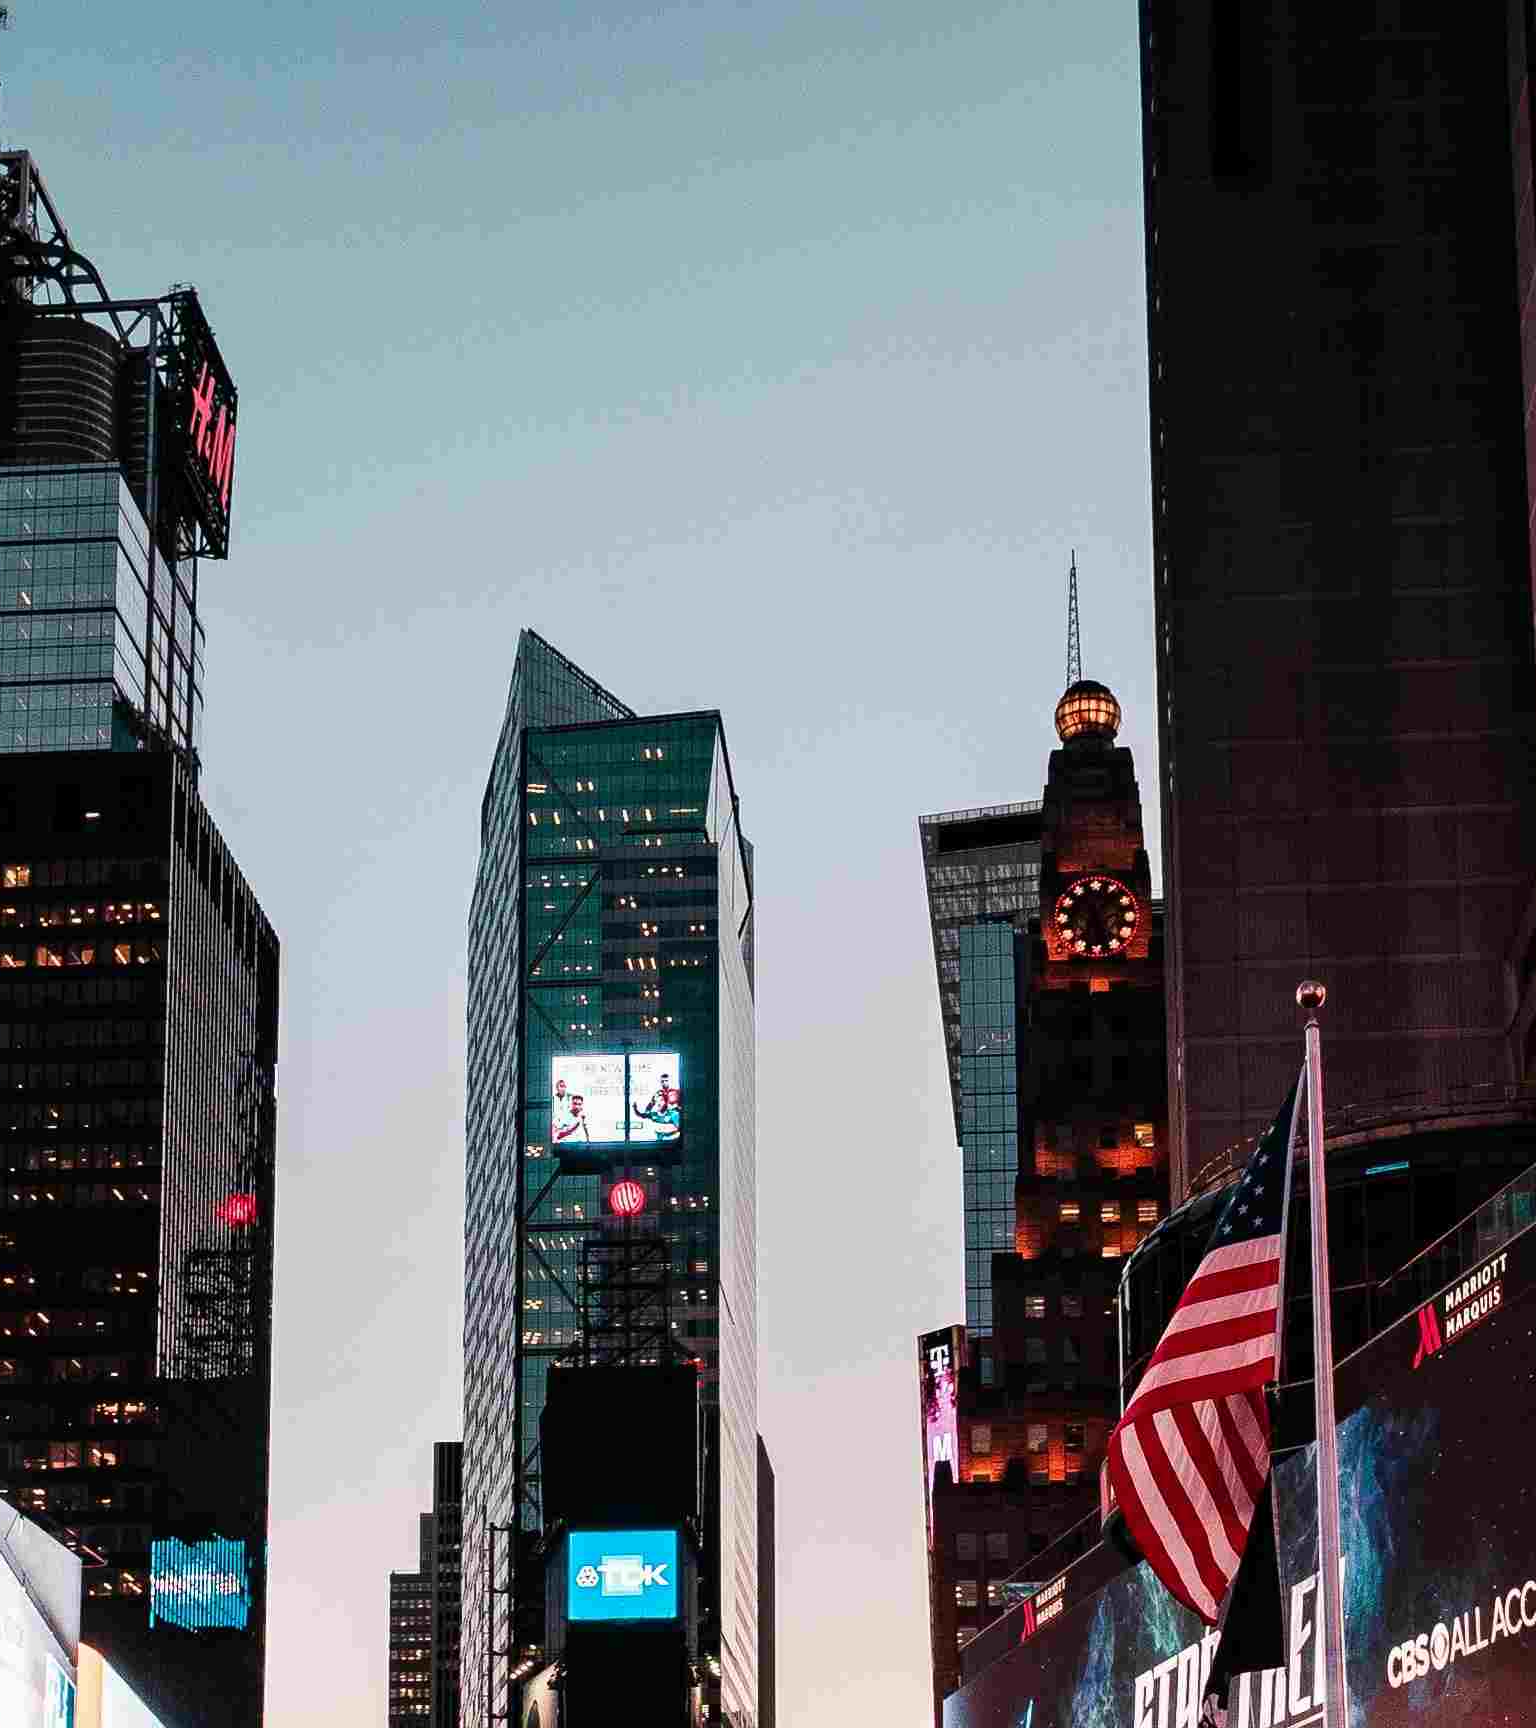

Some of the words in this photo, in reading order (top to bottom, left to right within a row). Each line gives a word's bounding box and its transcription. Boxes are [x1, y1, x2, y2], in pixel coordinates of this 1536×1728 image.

[1444, 1253, 1508, 1313] MARRIOTT
[1445, 1285, 1502, 1340] MARQUIS
[1387, 1638, 1430, 1690] CBS
[1450, 1605, 1491, 1666] ALL
